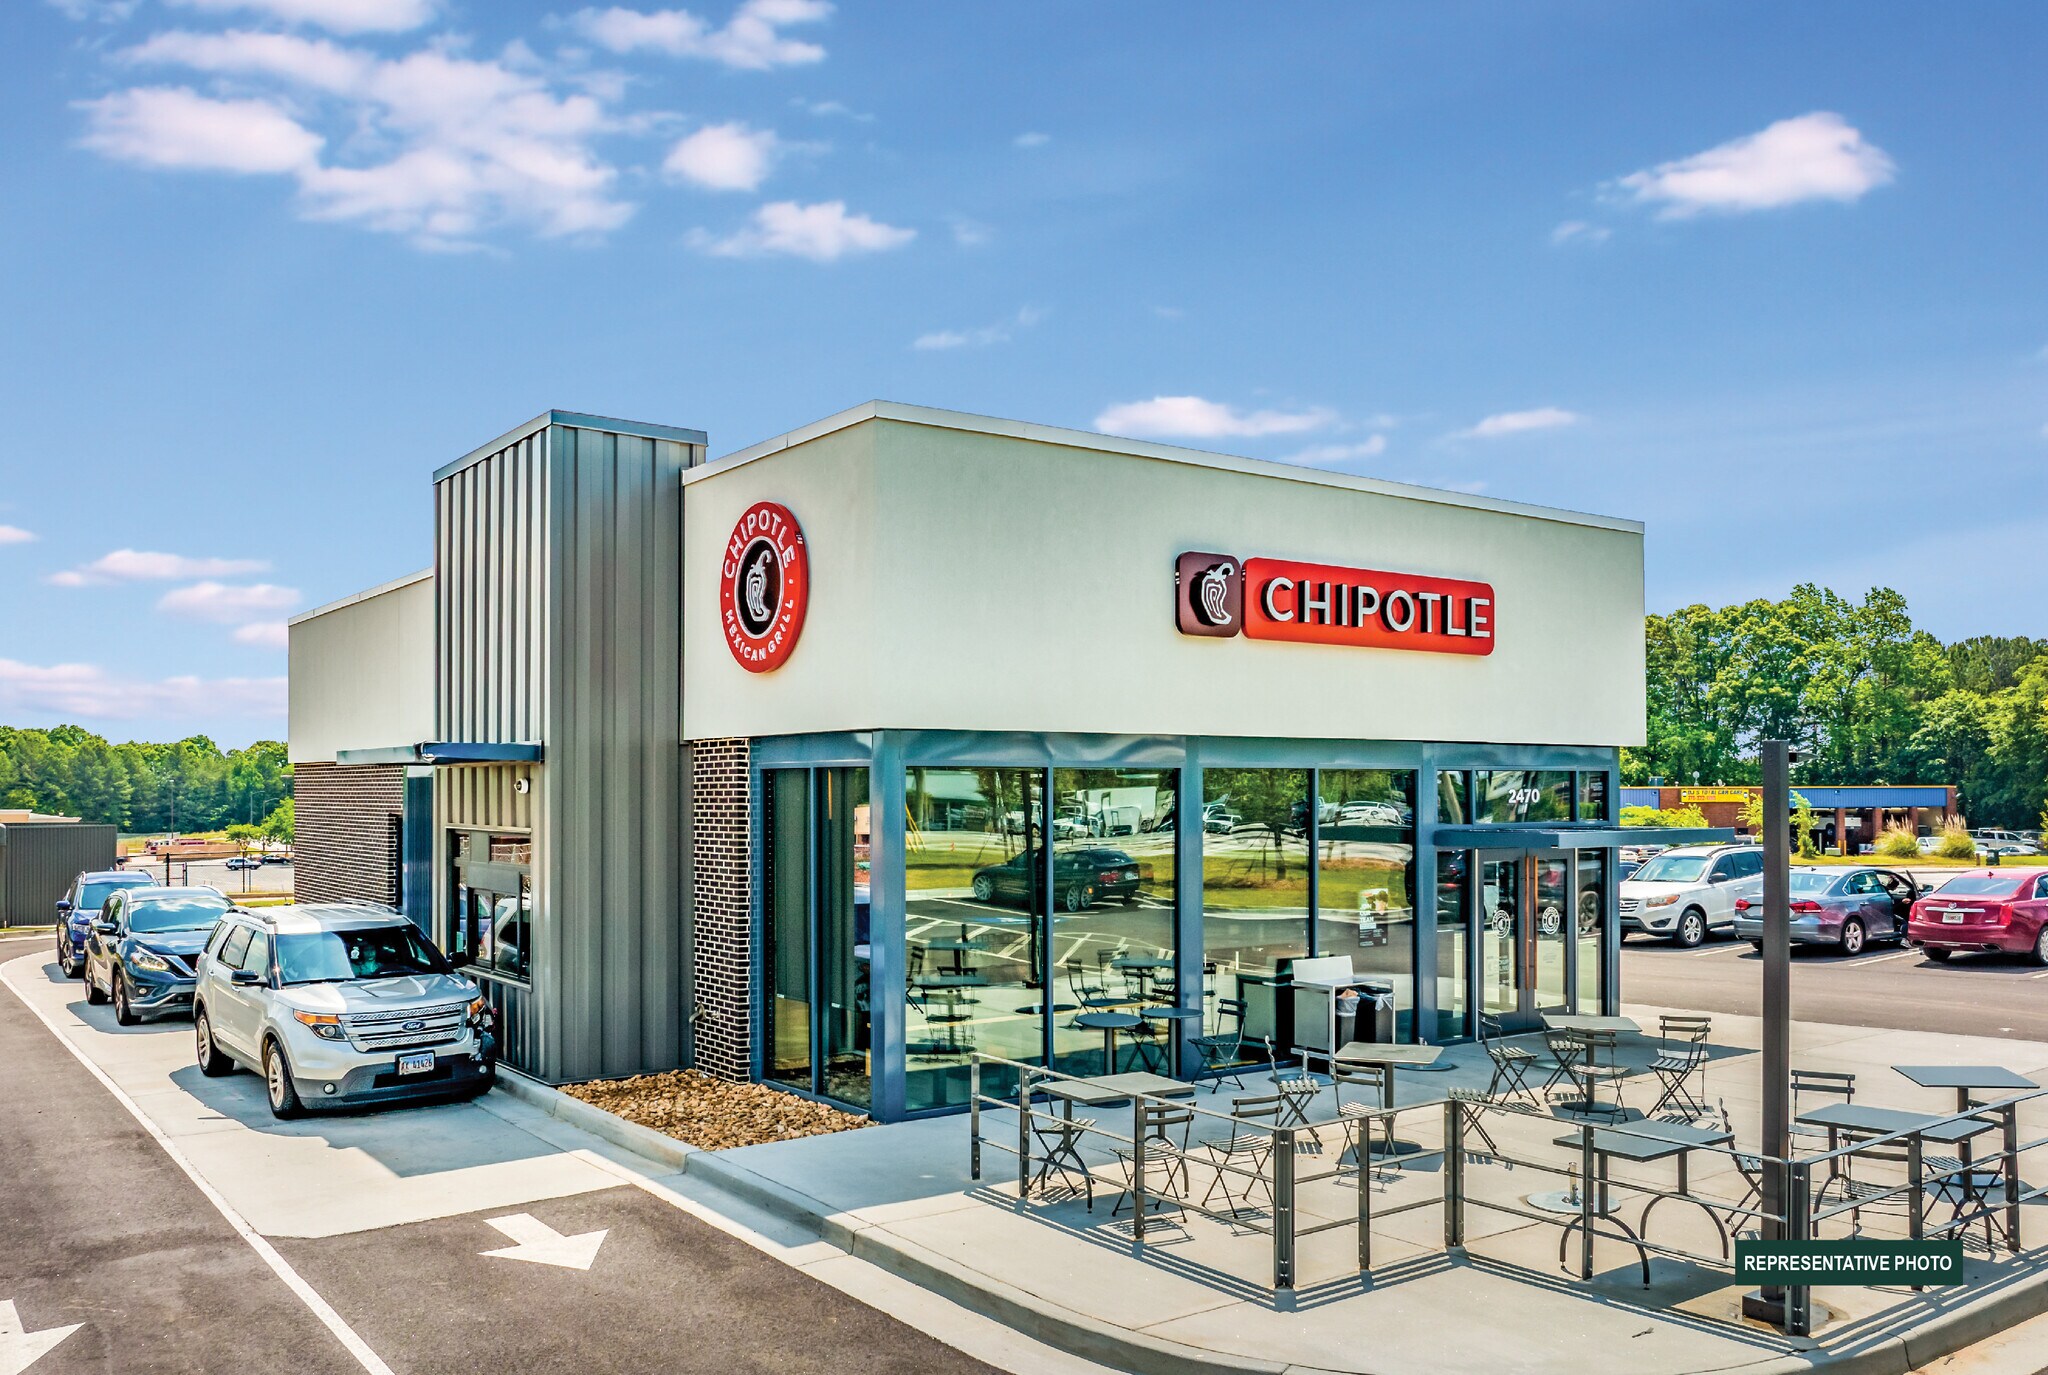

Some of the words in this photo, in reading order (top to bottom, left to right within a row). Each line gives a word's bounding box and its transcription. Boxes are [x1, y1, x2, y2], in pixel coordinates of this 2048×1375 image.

[725, 509, 795, 578] CHIPOTLE
[725, 609, 767, 661] MEXICAN
[768, 599, 794, 653] GRILL
[1262, 577, 1490, 637] CHIPOTLE
[1508, 788, 1540, 804] 2470
